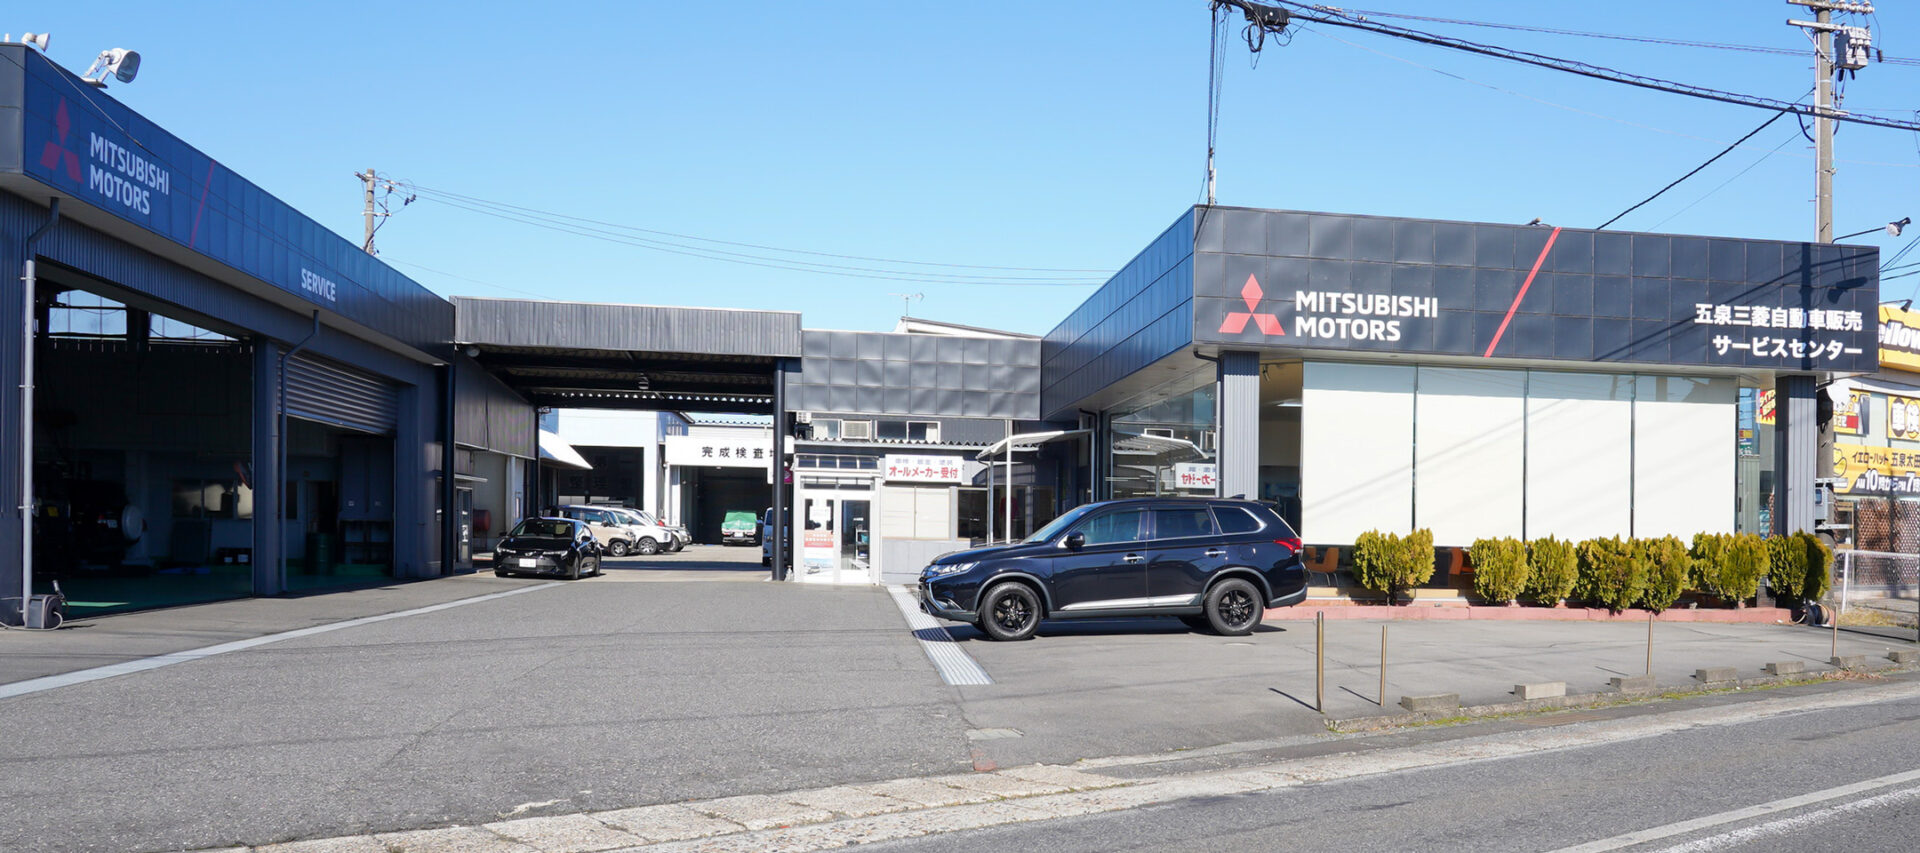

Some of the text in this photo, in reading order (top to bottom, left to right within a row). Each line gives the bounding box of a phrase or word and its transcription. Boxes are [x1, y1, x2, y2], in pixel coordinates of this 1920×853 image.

[90, 131, 169, 195] MITSUBISHI
[90, 164, 150, 215] MOTORS
[301, 268, 336, 302] SERVICE
[1295, 290, 1438, 318] MITSUBISHI
[1694, 303, 1863, 332] 五泉三菱自動車販売
[1295, 316, 1401, 342] MOTORS
[1712, 335, 1863, 360] サービスセンター
[889, 465, 959, 478] オールメーカー受付
